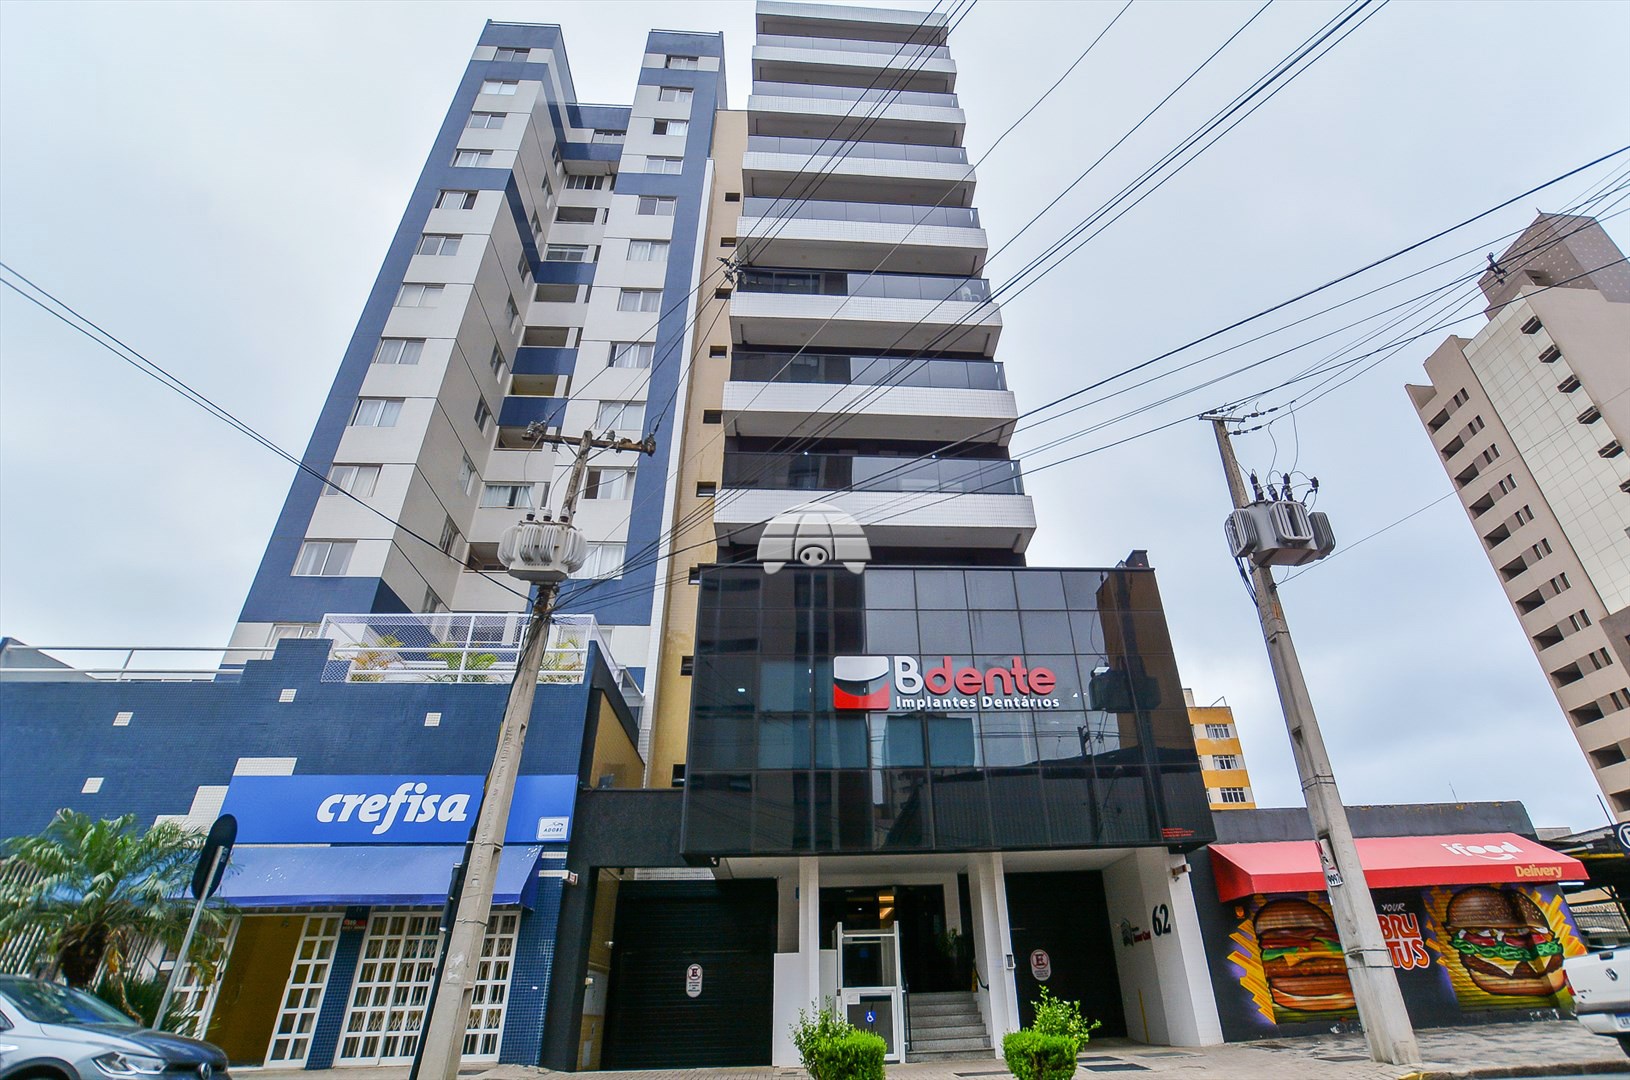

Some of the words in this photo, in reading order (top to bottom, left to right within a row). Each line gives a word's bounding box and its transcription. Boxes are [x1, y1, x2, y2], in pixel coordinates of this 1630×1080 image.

[894, 655, 1057, 695] Bdente
[896, 696, 977, 711] Implantes
[982, 695, 1060, 708] Dentários
[316, 782, 471, 835] crefisa
[1514, 863, 1563, 878] Delivery
[1381, 902, 1406, 912] YOUR
[1152, 903, 1172, 937] 62
